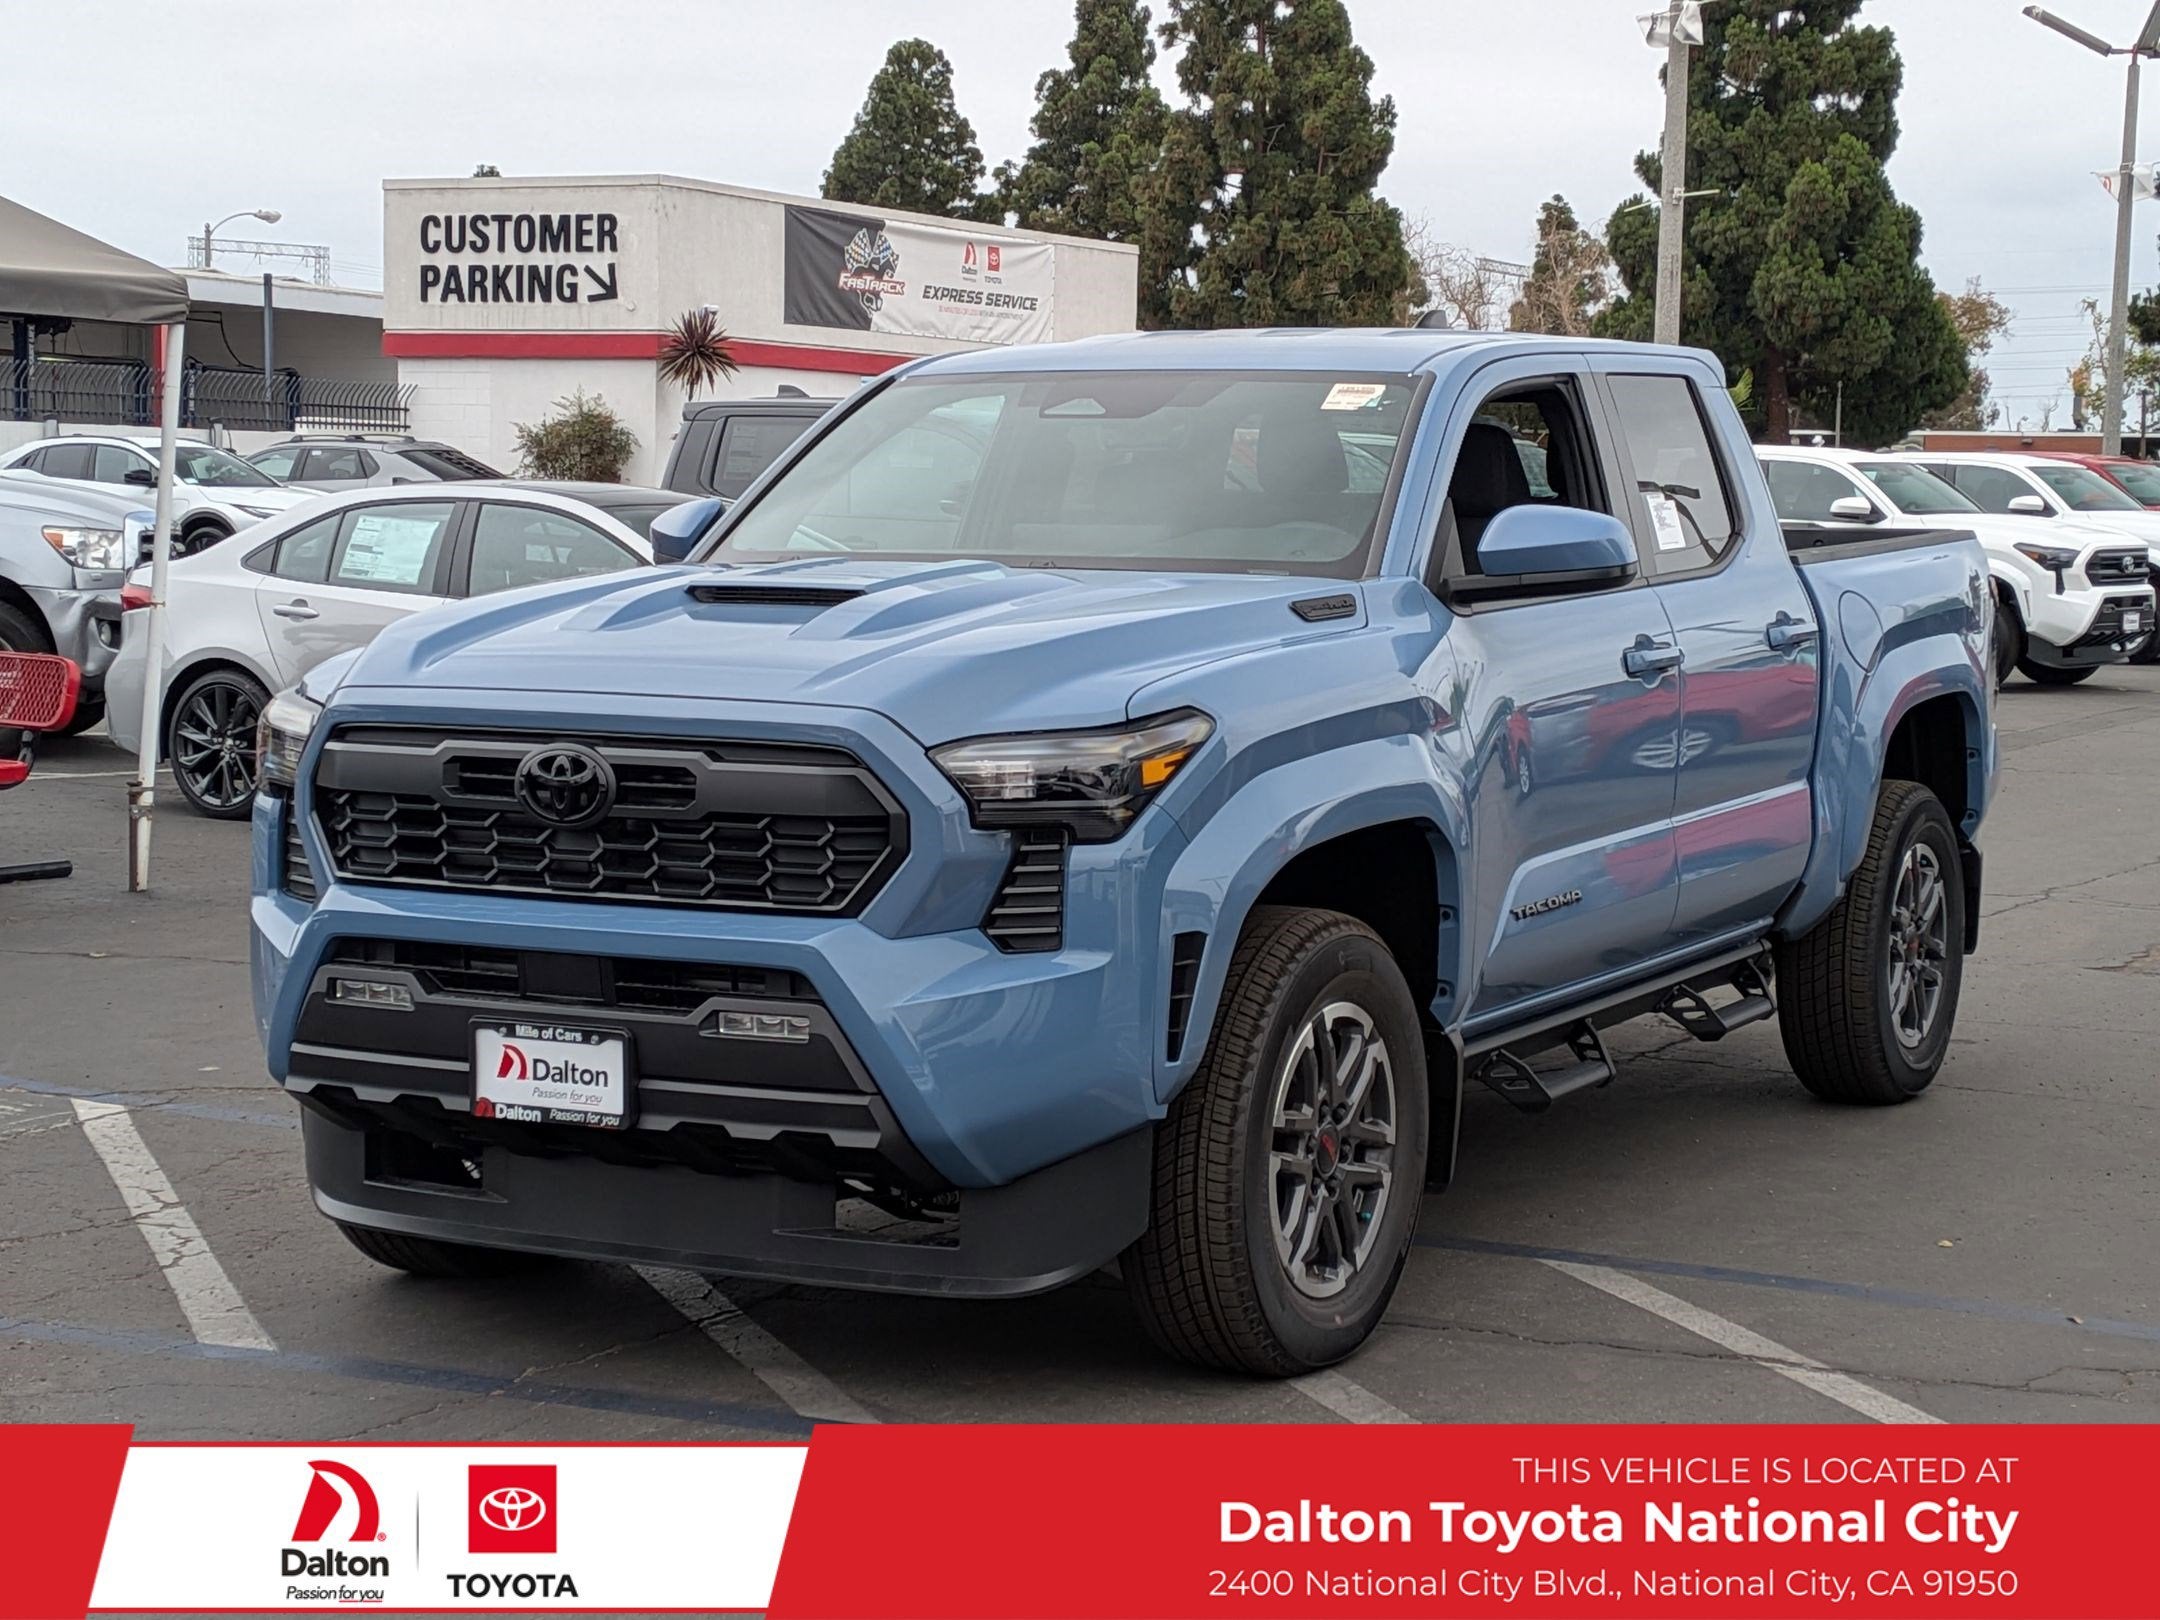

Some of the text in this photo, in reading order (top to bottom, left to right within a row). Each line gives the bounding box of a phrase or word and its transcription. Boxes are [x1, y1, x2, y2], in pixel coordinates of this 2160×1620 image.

[420, 213, 618, 253] CUSTOMER
[420, 263, 579, 303] PARKING
[922, 285, 1039, 311] EXPRESS SERVICE
[1510, 889, 1583, 921] TACOMA
[515, 1024, 583, 1043] Mile of Cars
[532, 1058, 609, 1088] Dalton
[532, 1087, 604, 1105] Passion for you
[494, 1103, 621, 1127] Dalton Passion for you
